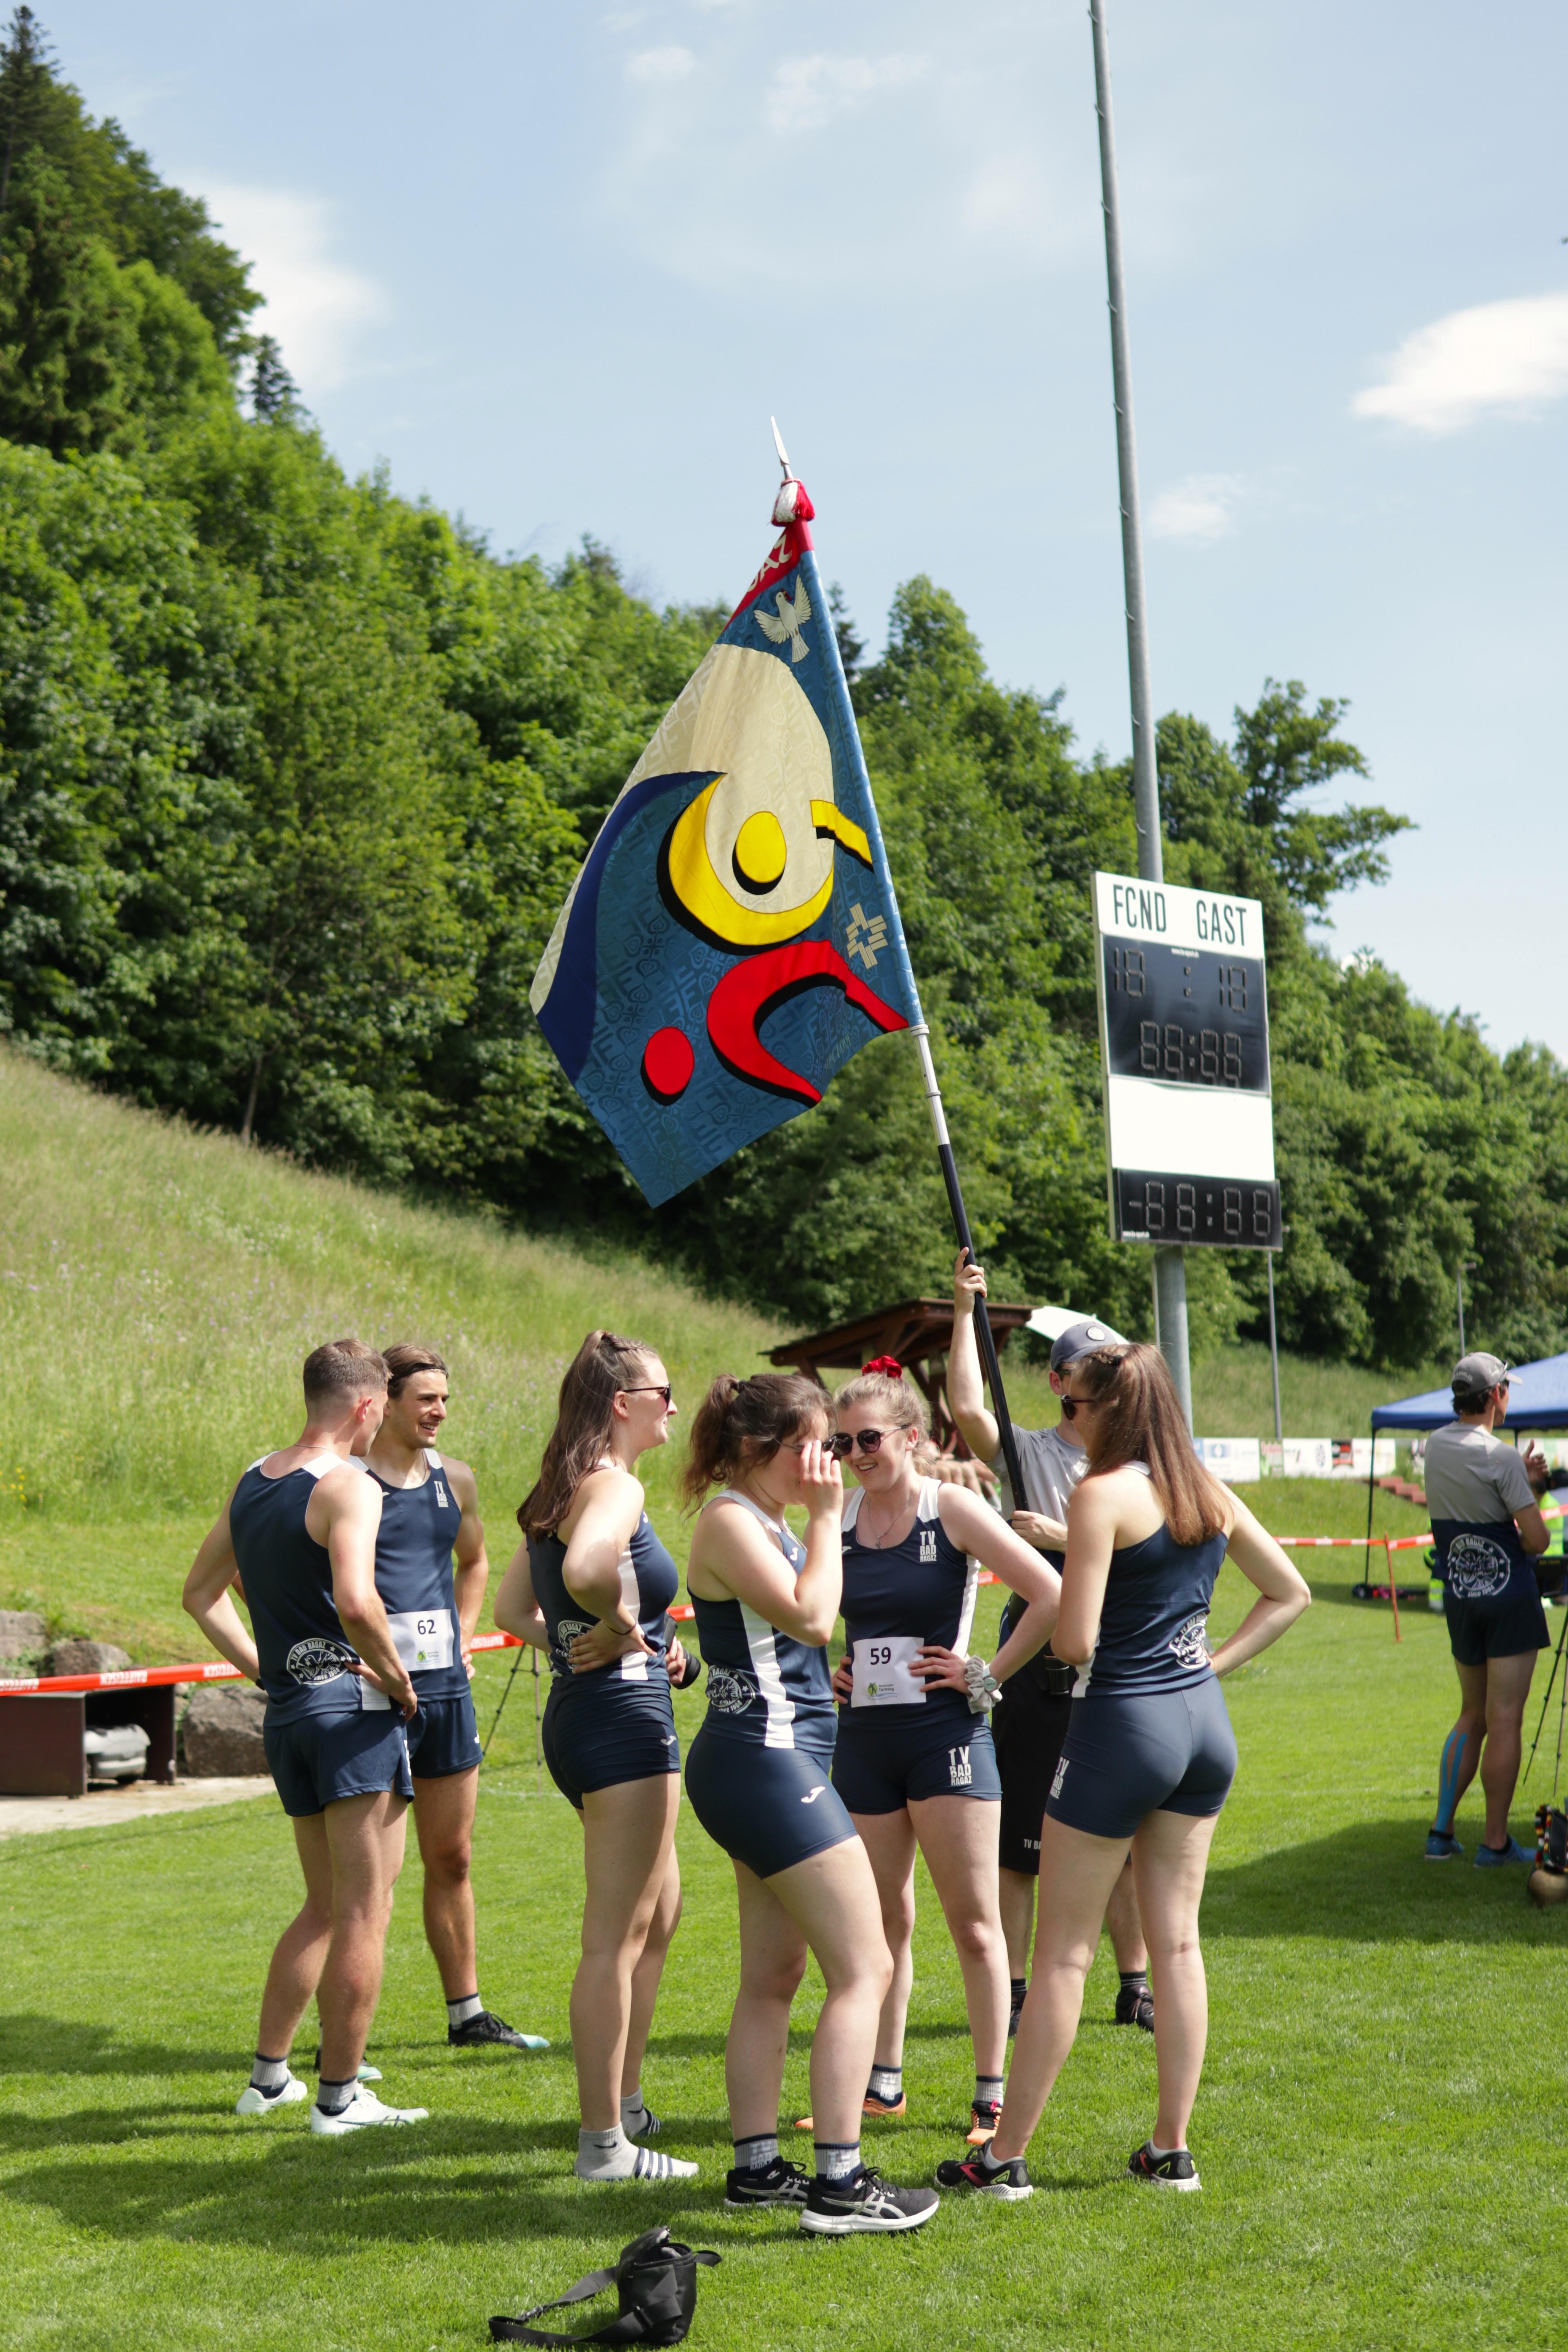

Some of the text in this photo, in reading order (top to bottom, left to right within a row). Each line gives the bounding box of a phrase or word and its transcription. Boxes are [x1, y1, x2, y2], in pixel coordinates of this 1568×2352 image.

[1113, 884, 1247, 946] FCND GAST
[434, 1480, 445, 1493] TV
[920, 1530, 935, 1546] TV
[920, 1544, 936, 1556] BAD
[417, 1619, 436, 1635] 62
[291, 1641, 326, 1661] TV BAD RAGAZ
[870, 1646, 891, 1665] 59
[948, 1746, 969, 1766] TV
[949, 1764, 971, 1778] BAD
[951, 1775, 972, 1786] RAGAZ
[1024, 1838, 1032, 1849] TV
